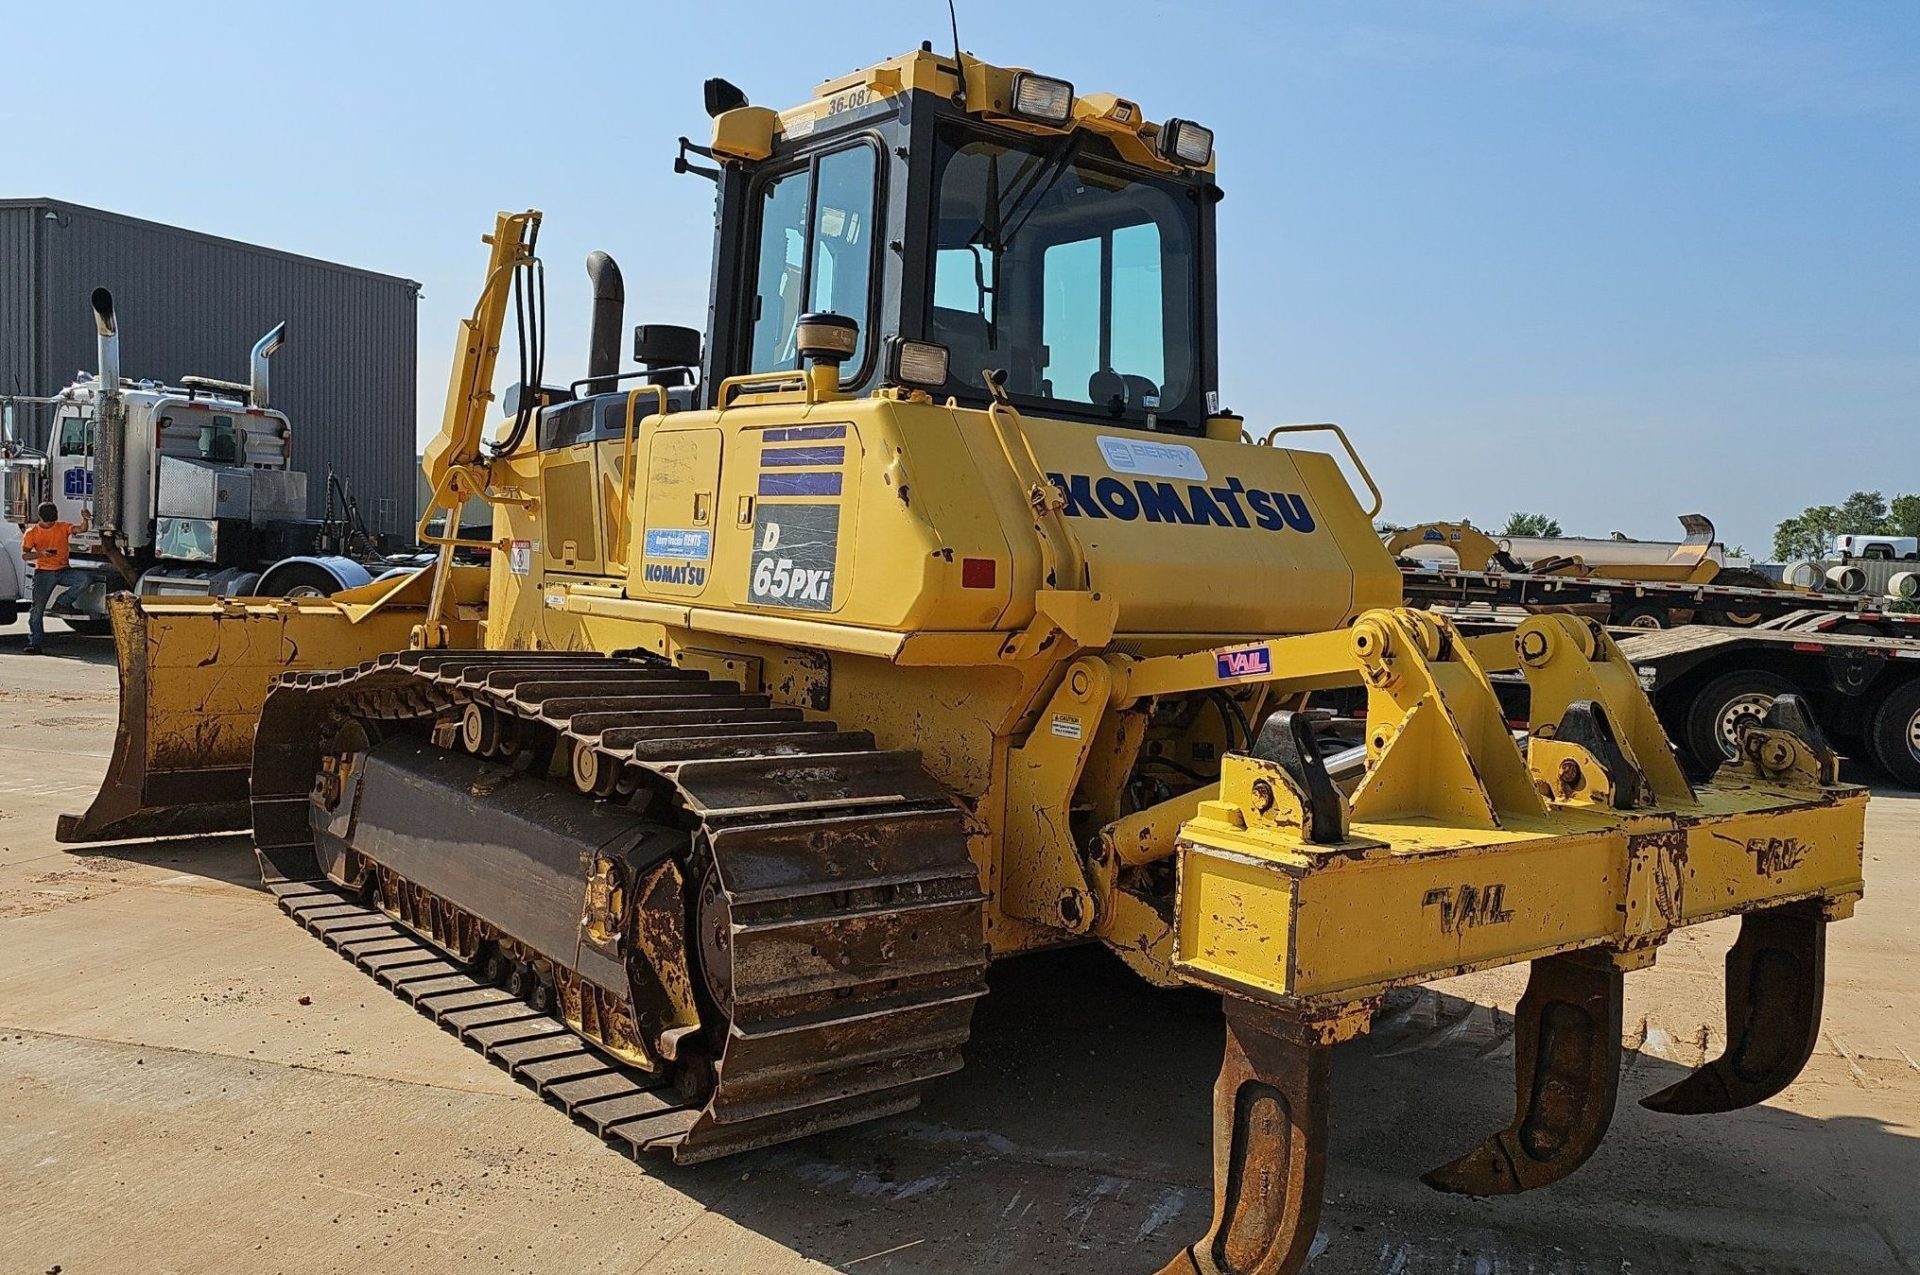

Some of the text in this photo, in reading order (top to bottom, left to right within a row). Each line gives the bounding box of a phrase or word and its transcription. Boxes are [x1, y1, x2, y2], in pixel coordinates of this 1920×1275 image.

[1045, 472, 1316, 533] KOMATSU
[761, 522, 780, 552] D
[645, 561, 705, 586] KOMATSU
[753, 557, 830, 601] 65PXi
[1219, 652, 1268, 675] VAIL
